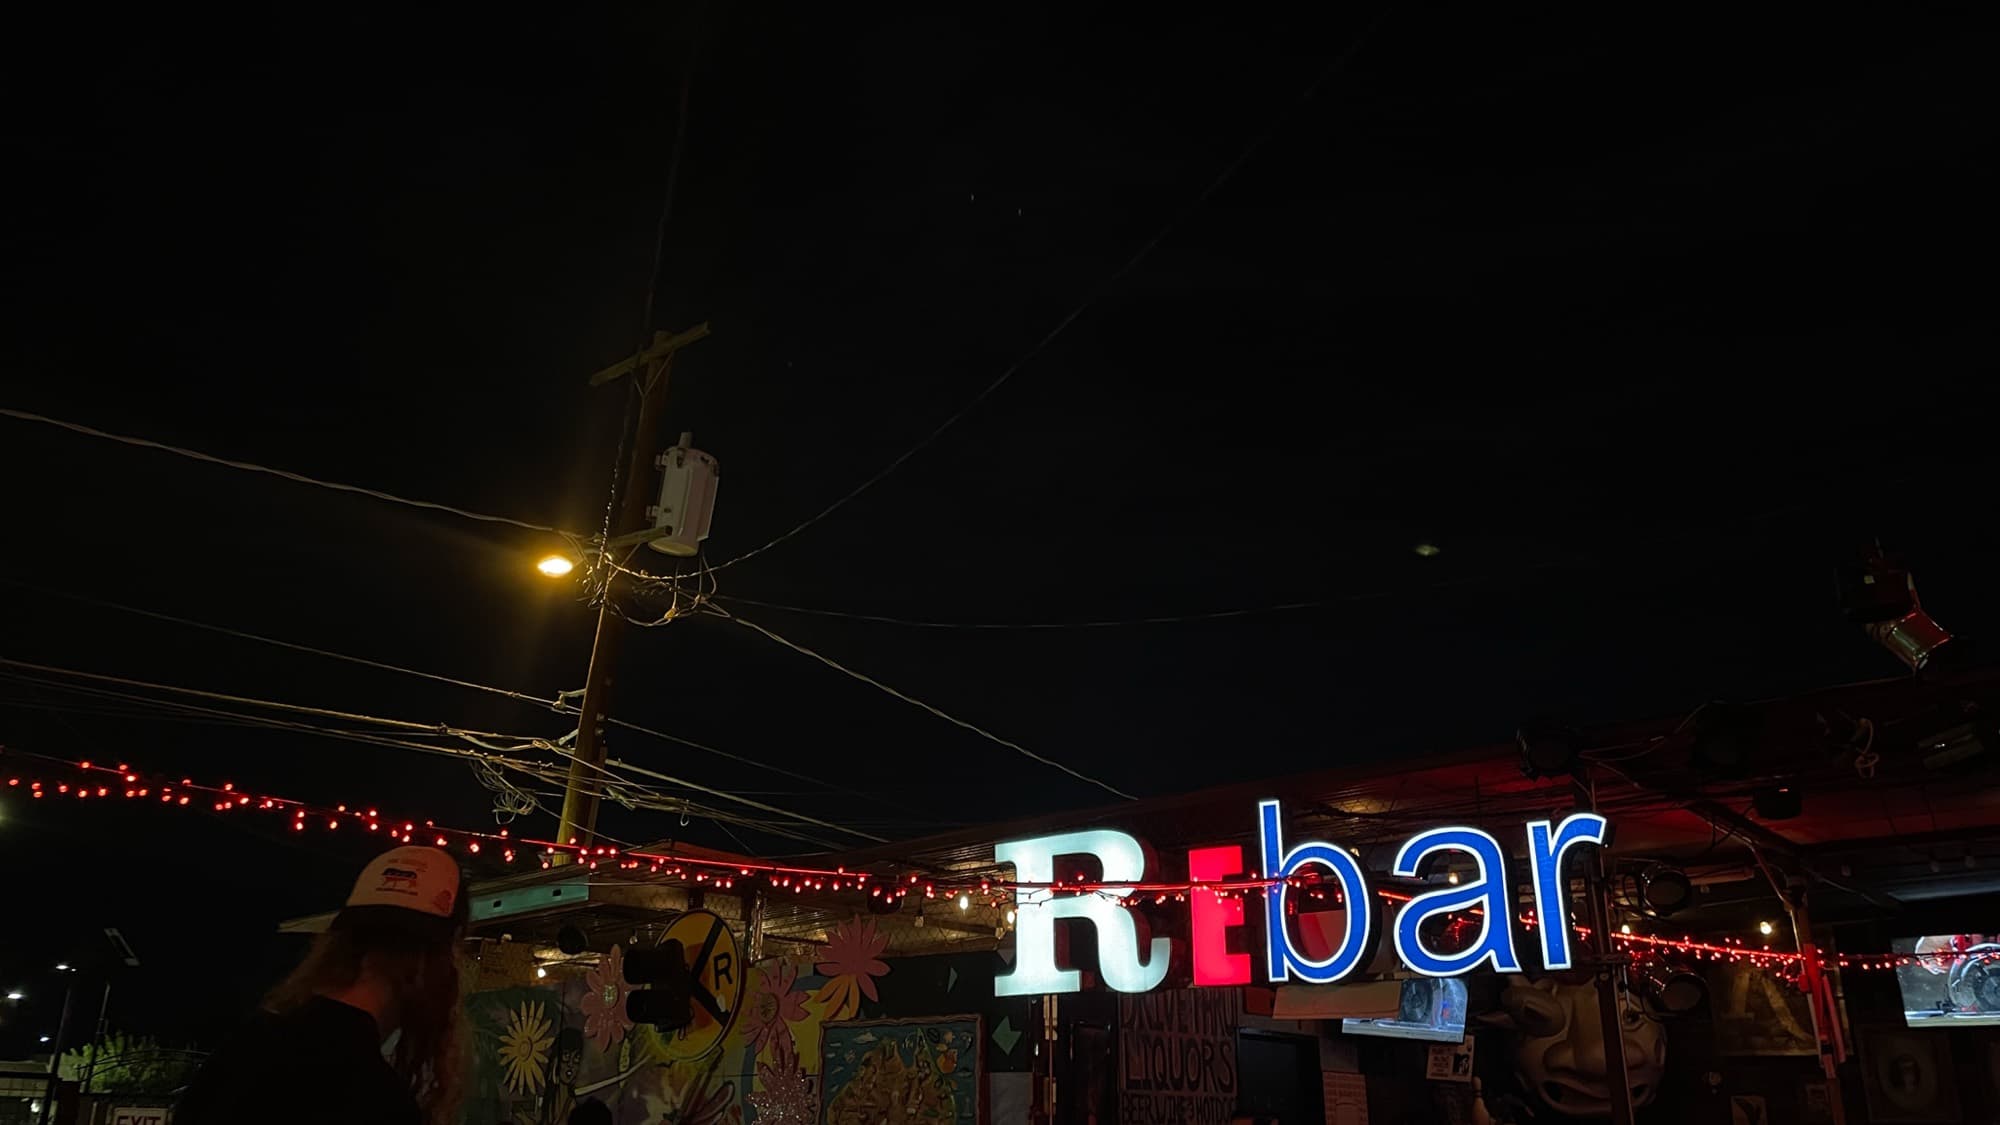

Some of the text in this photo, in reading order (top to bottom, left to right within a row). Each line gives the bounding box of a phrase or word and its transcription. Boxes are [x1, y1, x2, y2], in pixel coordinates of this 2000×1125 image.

[713, 951, 733, 991] R
[1124, 1033, 1234, 1093] LIQUORS
[1121, 1092, 1154, 1124] BEER
